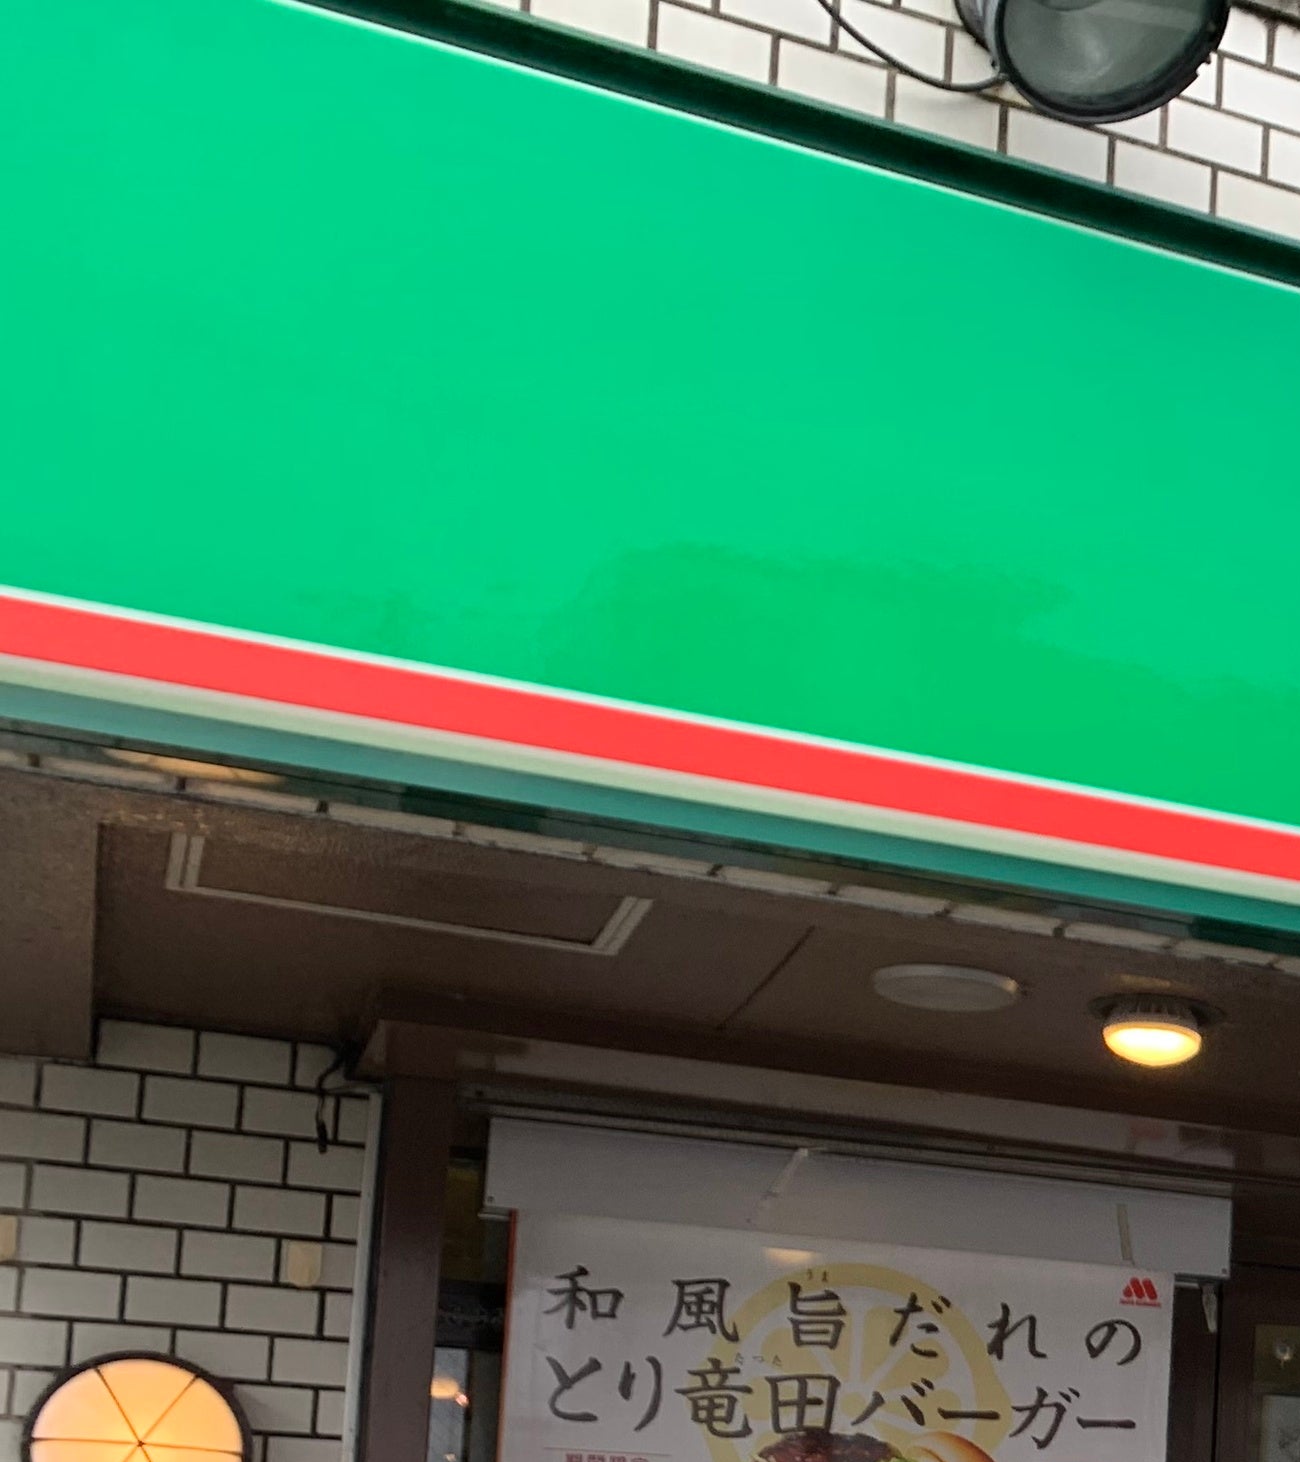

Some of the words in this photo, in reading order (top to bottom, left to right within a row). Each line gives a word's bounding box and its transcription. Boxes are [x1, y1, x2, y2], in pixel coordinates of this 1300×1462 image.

[543, 1264, 1142, 1366] 和風旨だれの
[546, 1355, 1137, 1450] とり竜田バーガー
